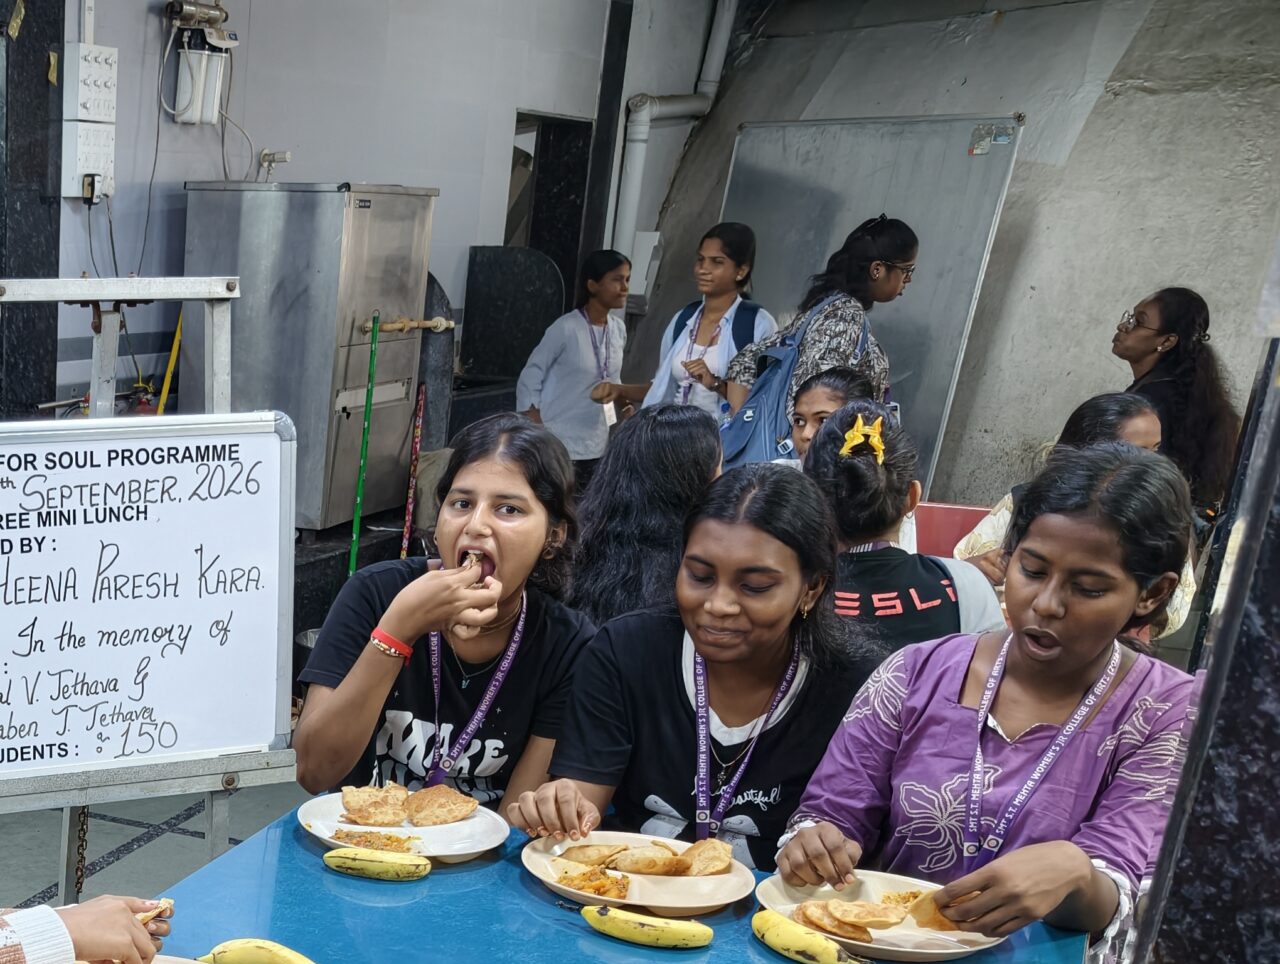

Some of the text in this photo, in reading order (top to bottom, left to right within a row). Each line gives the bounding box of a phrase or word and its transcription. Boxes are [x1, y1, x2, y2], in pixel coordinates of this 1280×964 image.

[44, 450, 101, 471] SOUL
[107, 444, 240, 467] PROGRAMME
[188, 460, 263, 501] 2026
[37, 508, 77, 528] MINI
[83, 504, 148, 525] LUNCH
[20, 536, 47, 555] BY
[92, 540, 180, 604] PARESH
[12, 610, 234, 658] In the memory of
[500, 642, 518, 671] COLLEGE
[696, 664, 703, 674] OF
[47, 668, 120, 702] Jethava
[496, 670, 505, 682] JR
[696, 674, 706, 706] COLLEGE
[480, 680, 499, 712] WOMEN'S
[978, 690, 993, 722] COLLEGE
[986, 678, 996, 688] OF
[78, 700, 157, 732] Jethava
[466, 710, 484, 734] MEHTA
[698, 707, 707, 717] JR
[113, 721, 178, 759] 150
[376, 710, 510, 779] MAKE
[698, 718, 707, 752] WOMEN'S
[450, 744, 462, 758] SMT
[996, 818, 1008, 835] SMT
[1005, 806, 1018, 820] S.T.
[1012, 780, 1036, 806] MEHTA
[1030, 745, 1060, 780] WOMEN'S
[1056, 735, 1068, 747] JR
[1063, 705, 1090, 735] COLLEGE
[1085, 694, 1098, 706] OF
[699, 754, 707, 778] MEHTA
[698, 793, 706, 807] SMT
[970, 772, 982, 801] MEHTA
[970, 802, 979, 816] S.T.
[968, 818, 978, 833] SMT
